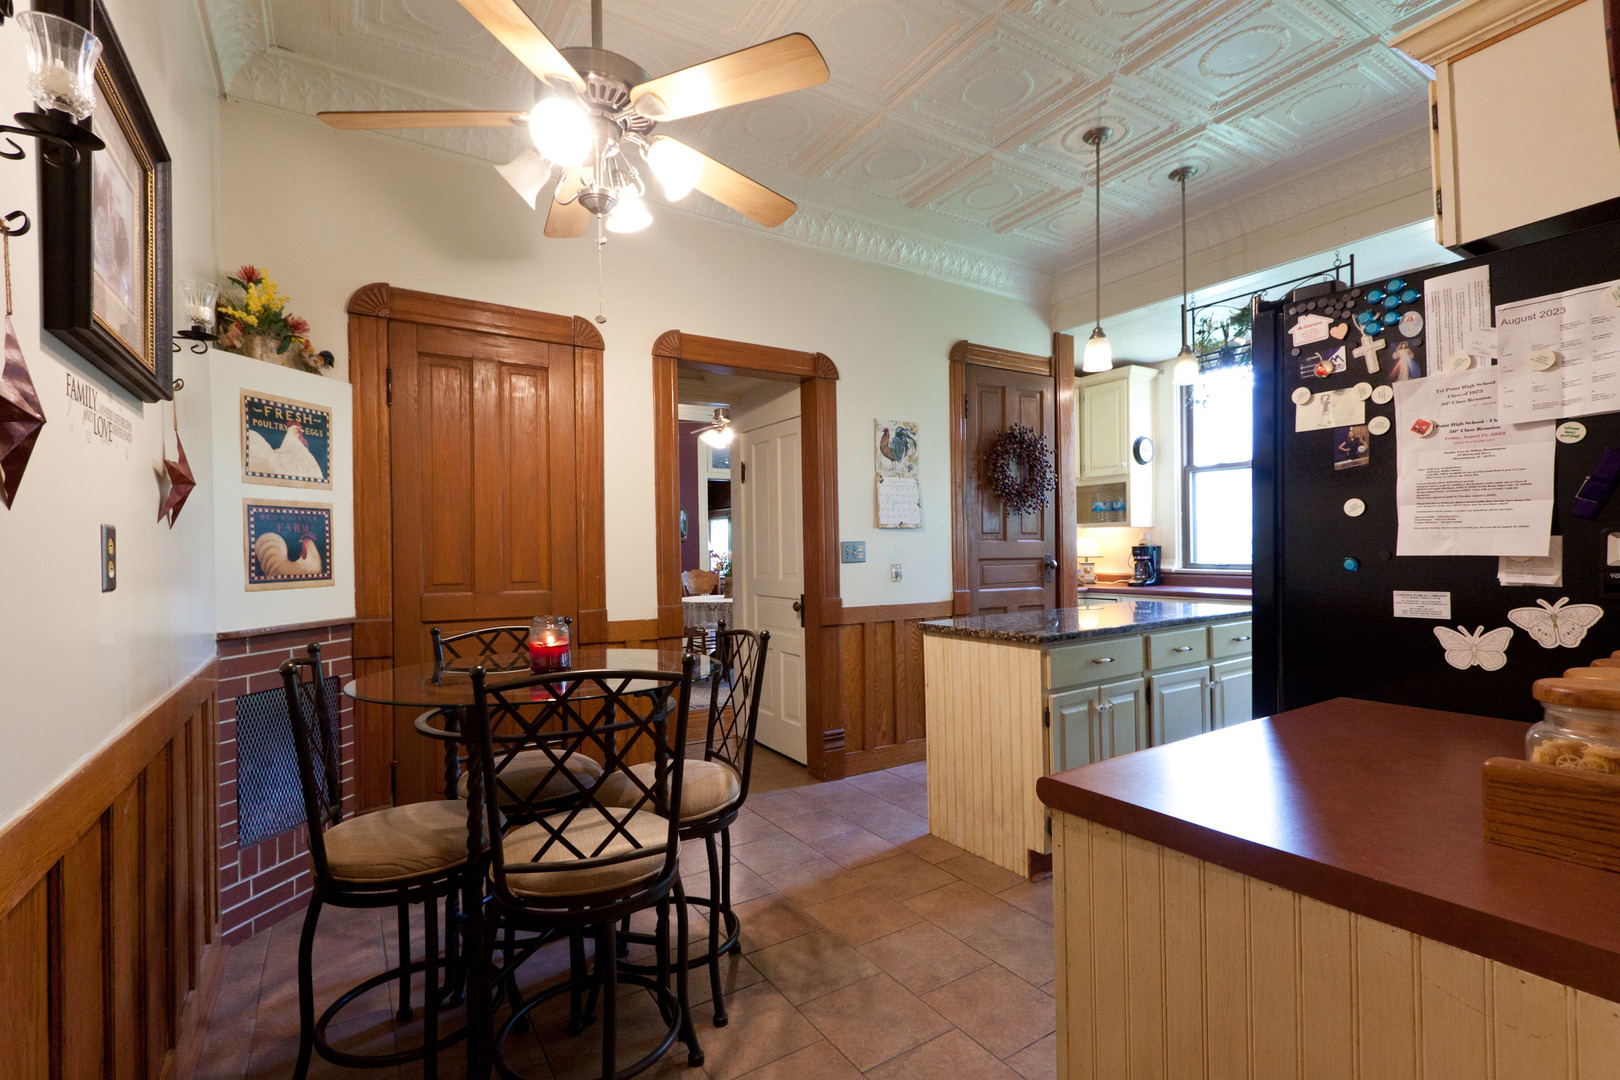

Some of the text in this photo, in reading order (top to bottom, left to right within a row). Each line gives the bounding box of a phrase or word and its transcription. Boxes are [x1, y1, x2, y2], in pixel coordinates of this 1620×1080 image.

[1501, 307, 1566, 326] August 2023
[264, 406, 313, 425] FRESH
[94, 413, 112, 442] LOVE
[252, 418, 324, 438] POULTRY EGGS
[277, 522, 309, 533] FARM
